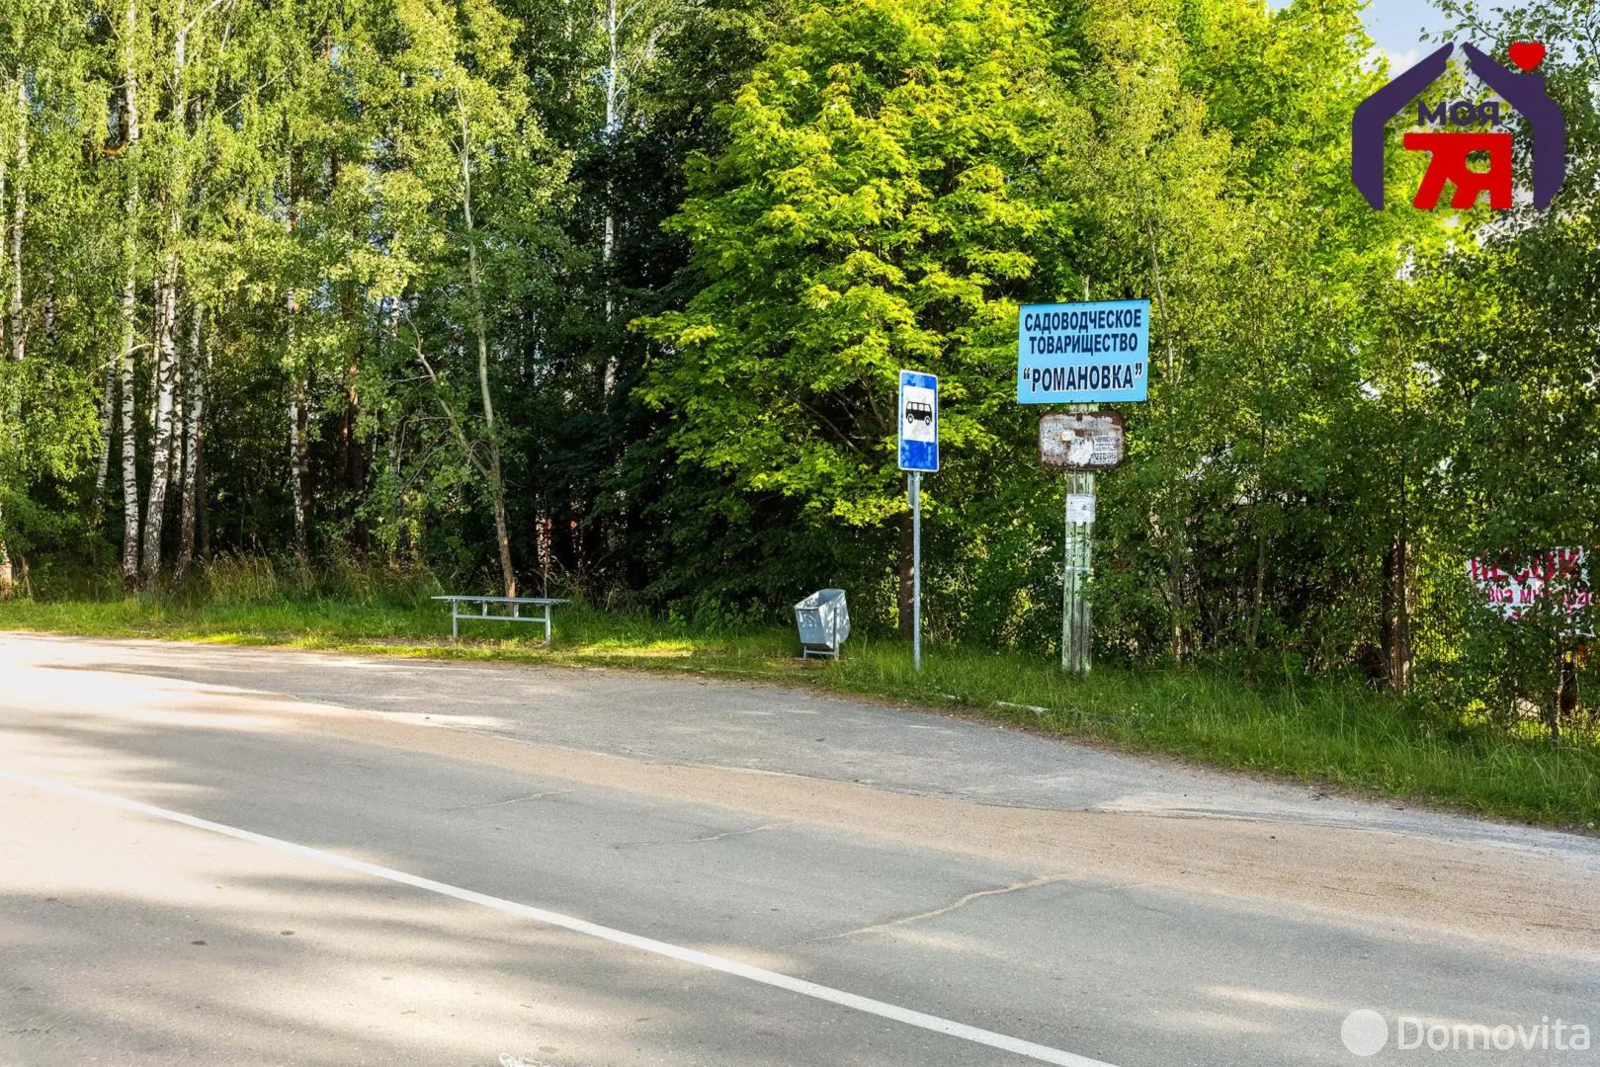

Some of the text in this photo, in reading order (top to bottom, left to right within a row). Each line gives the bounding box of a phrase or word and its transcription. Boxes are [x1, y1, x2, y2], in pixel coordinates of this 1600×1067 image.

[1025, 309, 1141, 334] САДОВОДЧЕСКОЕ
[1029, 333, 1138, 356] ТОВАРИЩЕСТВО
[1023, 363, 1143, 392] “РОМАНОВКА”
